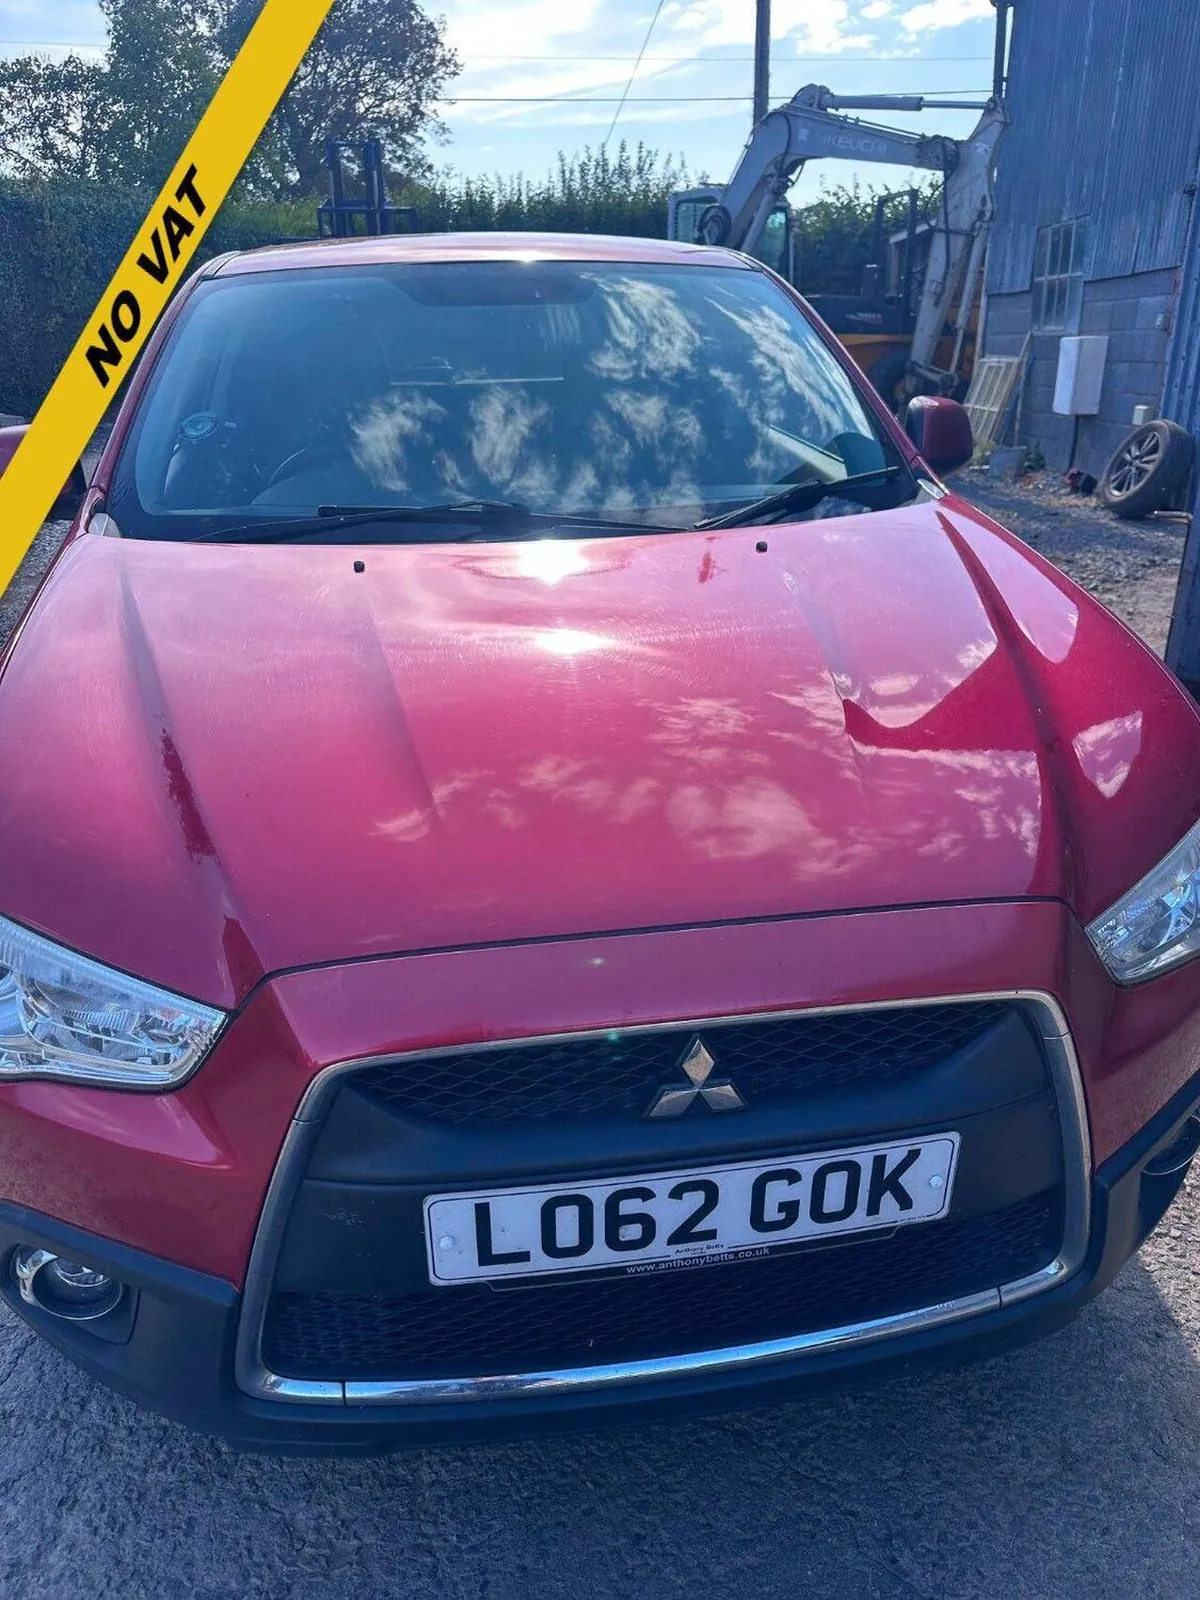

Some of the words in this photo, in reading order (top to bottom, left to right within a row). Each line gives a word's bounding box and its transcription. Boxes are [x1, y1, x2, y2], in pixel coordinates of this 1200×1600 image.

[475, 1179, 720, 1267] LO62
[749, 1148, 922, 1235] GOK
[626, 1247, 771, 1274] www.anthonybetts.co.uk
